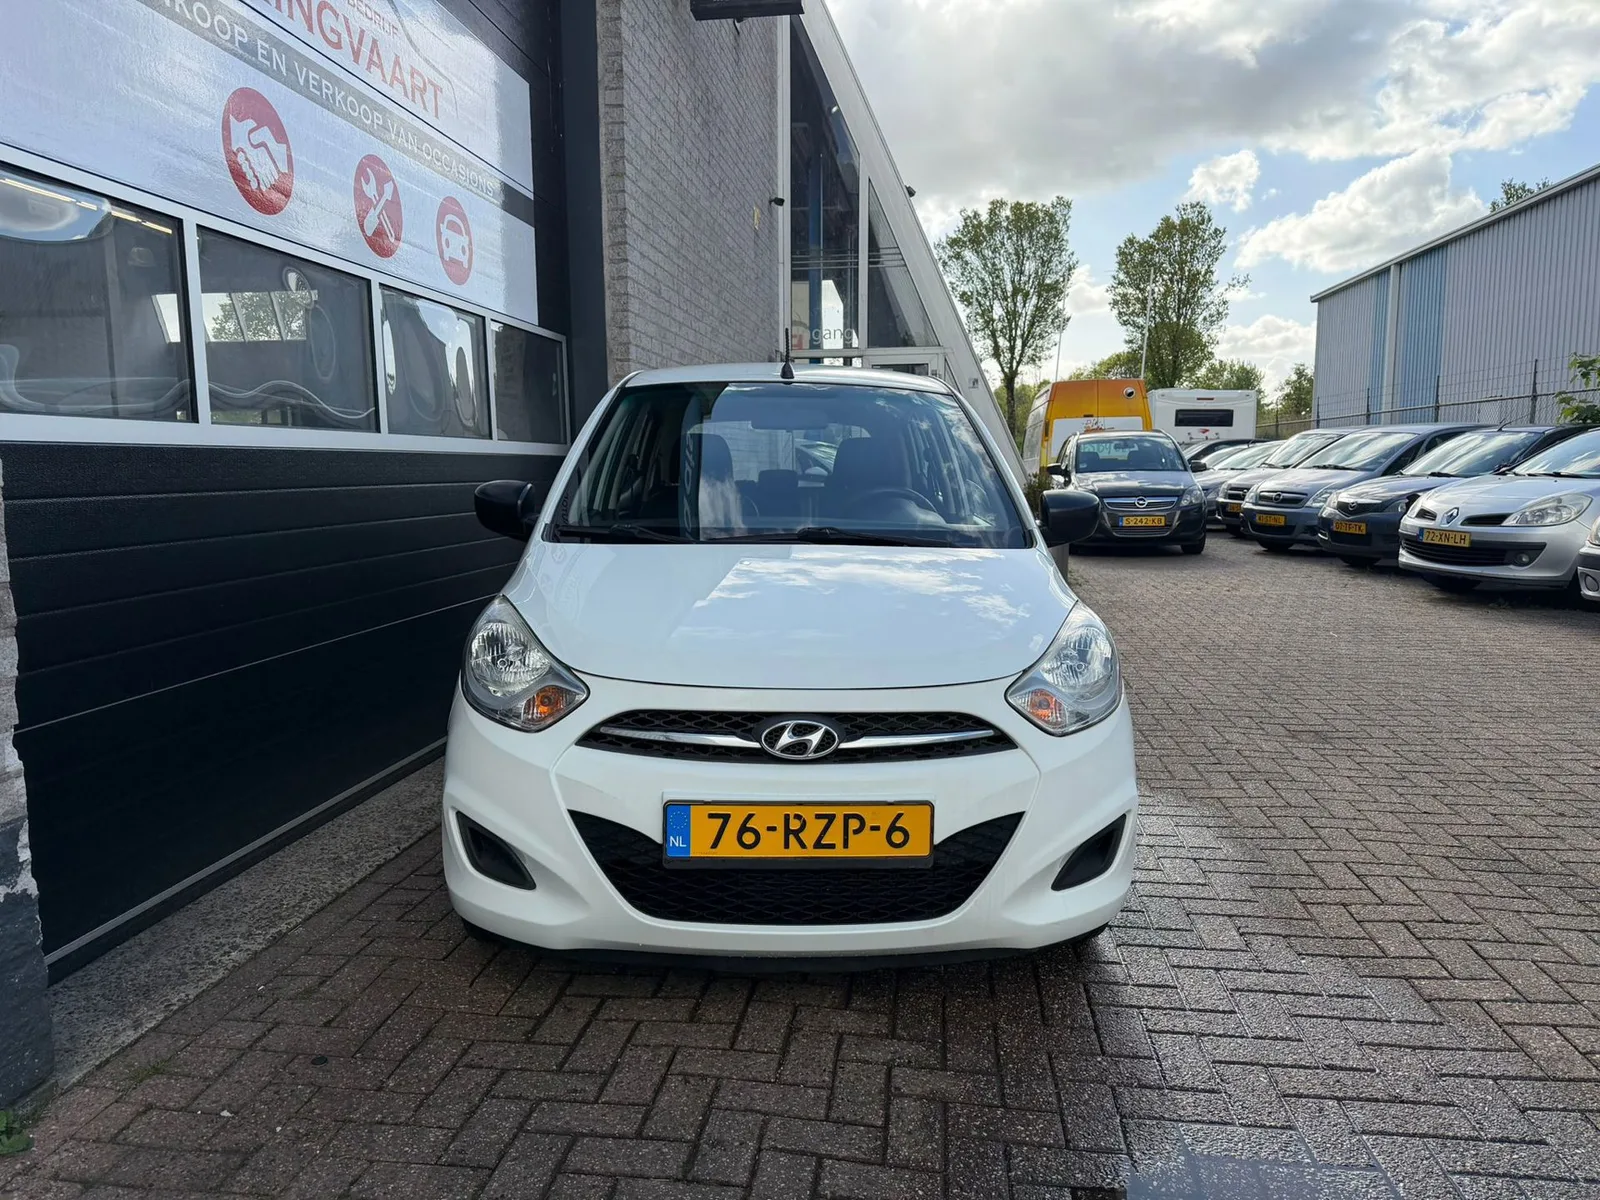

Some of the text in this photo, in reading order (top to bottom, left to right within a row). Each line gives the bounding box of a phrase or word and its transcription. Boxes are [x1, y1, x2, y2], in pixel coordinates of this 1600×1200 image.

[263, 0, 443, 120] NGVAART
[164, 0, 495, 197] KOOP EN VERKOOP VAN OCCASIONS
[806, 328, 855, 345] gang
[1425, 530, 1467, 545] 72-XN-LH
[669, 836, 687, 847] NL
[707, 812, 911, 850] 76-RZP-6
